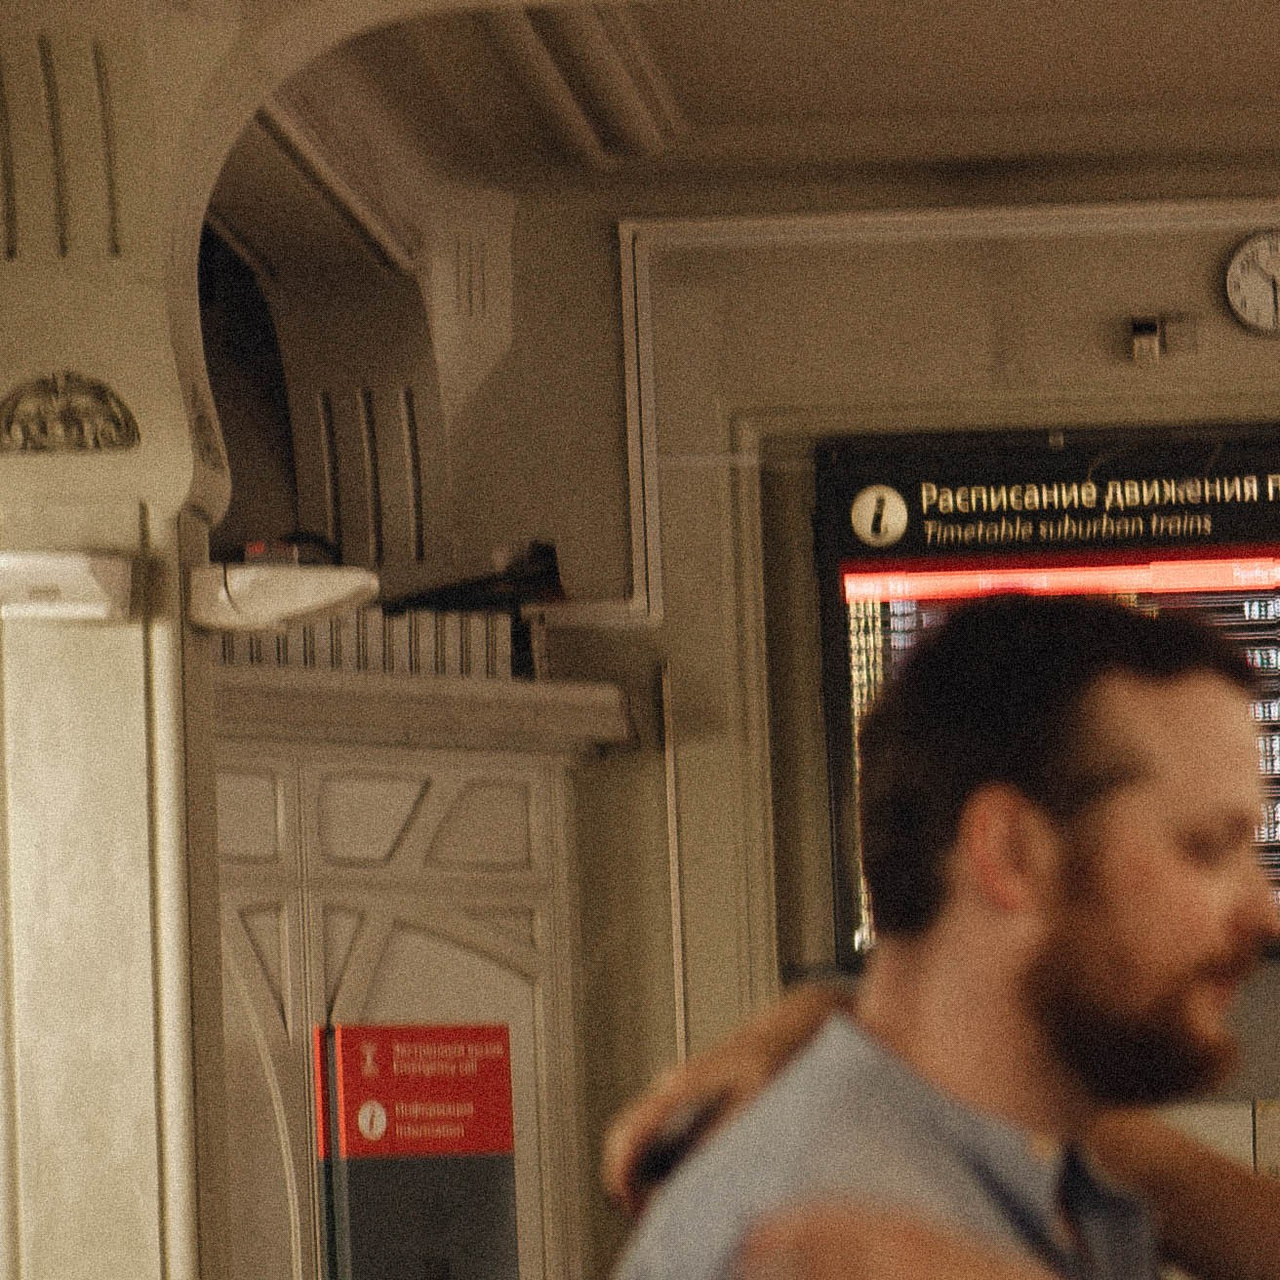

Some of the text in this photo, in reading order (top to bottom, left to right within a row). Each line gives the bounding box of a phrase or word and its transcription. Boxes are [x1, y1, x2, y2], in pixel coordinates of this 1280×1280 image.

[922, 481, 1097, 515] Расписание
[1104, 475, 1258, 511] движения
[924, 510, 1212, 546] Timetable suburban trains
